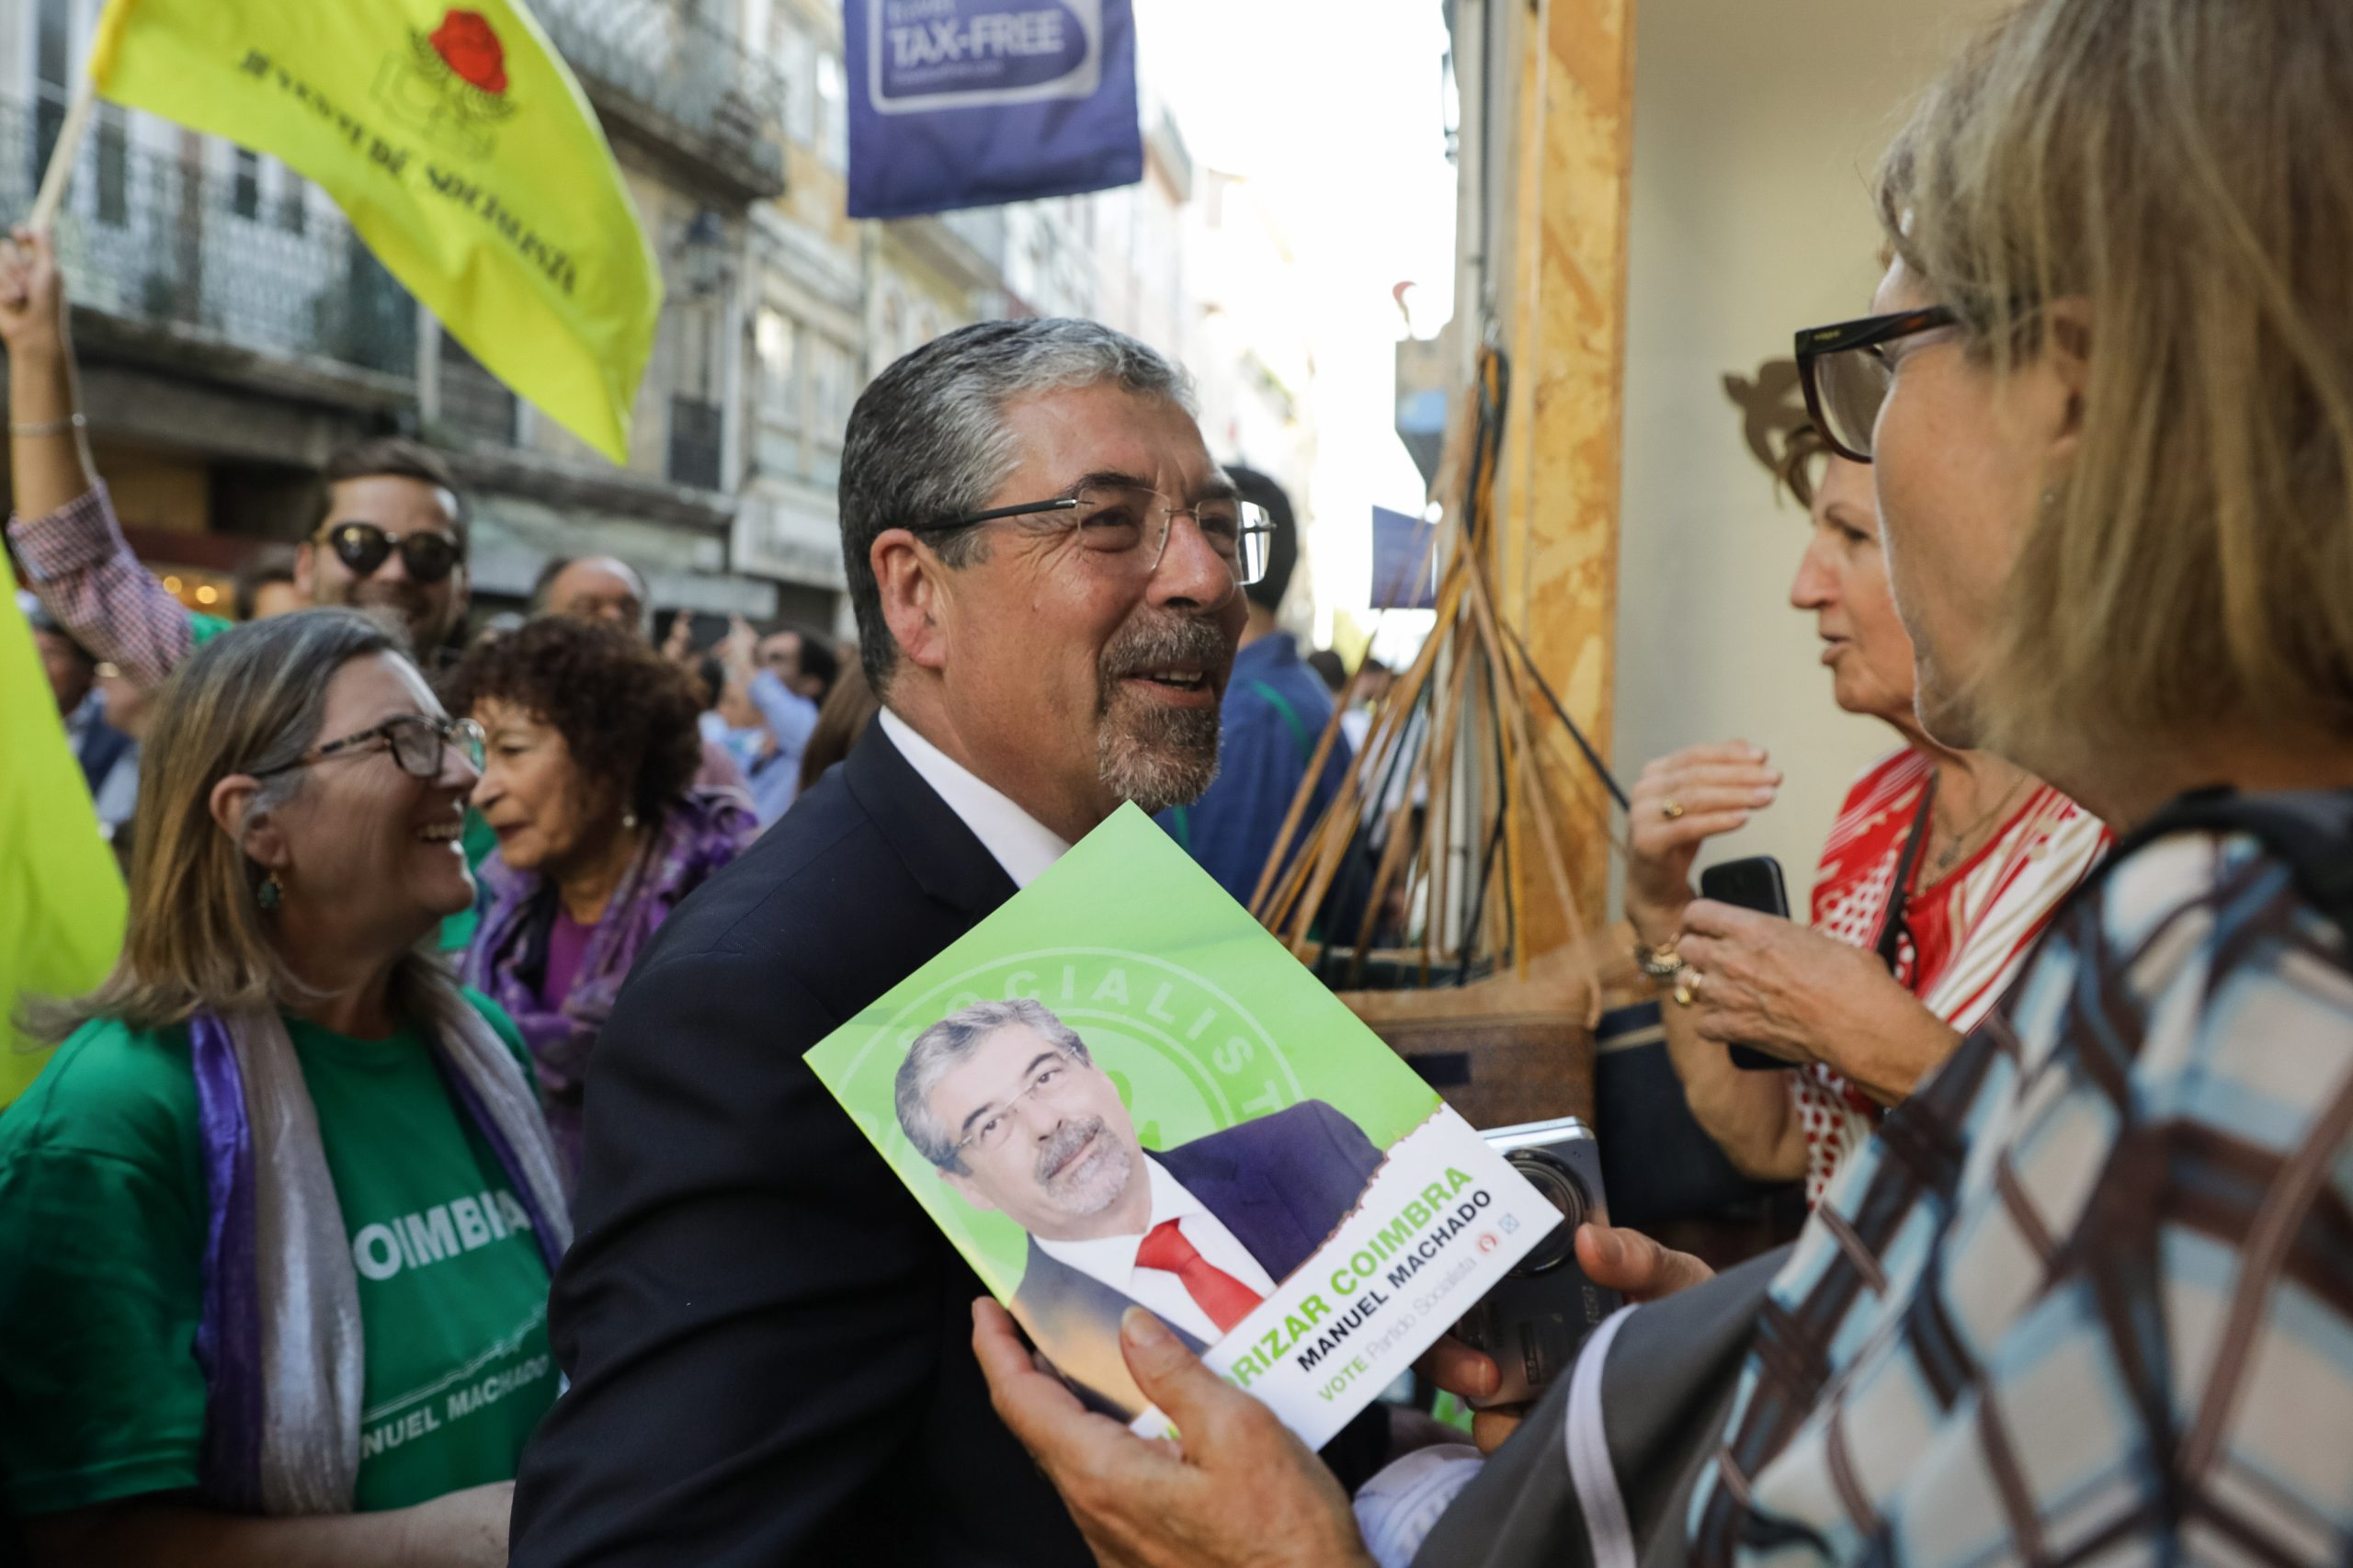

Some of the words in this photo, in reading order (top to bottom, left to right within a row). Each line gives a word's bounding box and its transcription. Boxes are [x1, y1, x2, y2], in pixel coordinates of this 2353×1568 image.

[888, 8, 1065, 67] TAX-FREE
[1221, 1294, 1331, 1388] RIZAR
[1331, 1166, 1472, 1296] COIMBRA
[1297, 1290, 1389, 1372] MANUEL
[1387, 1189, 1491, 1289] MACHADO
[1319, 1356, 1369, 1402] VOTE
[1366, 1312, 1416, 1358] Partido
[1413, 1256, 1477, 1315] Socialista
